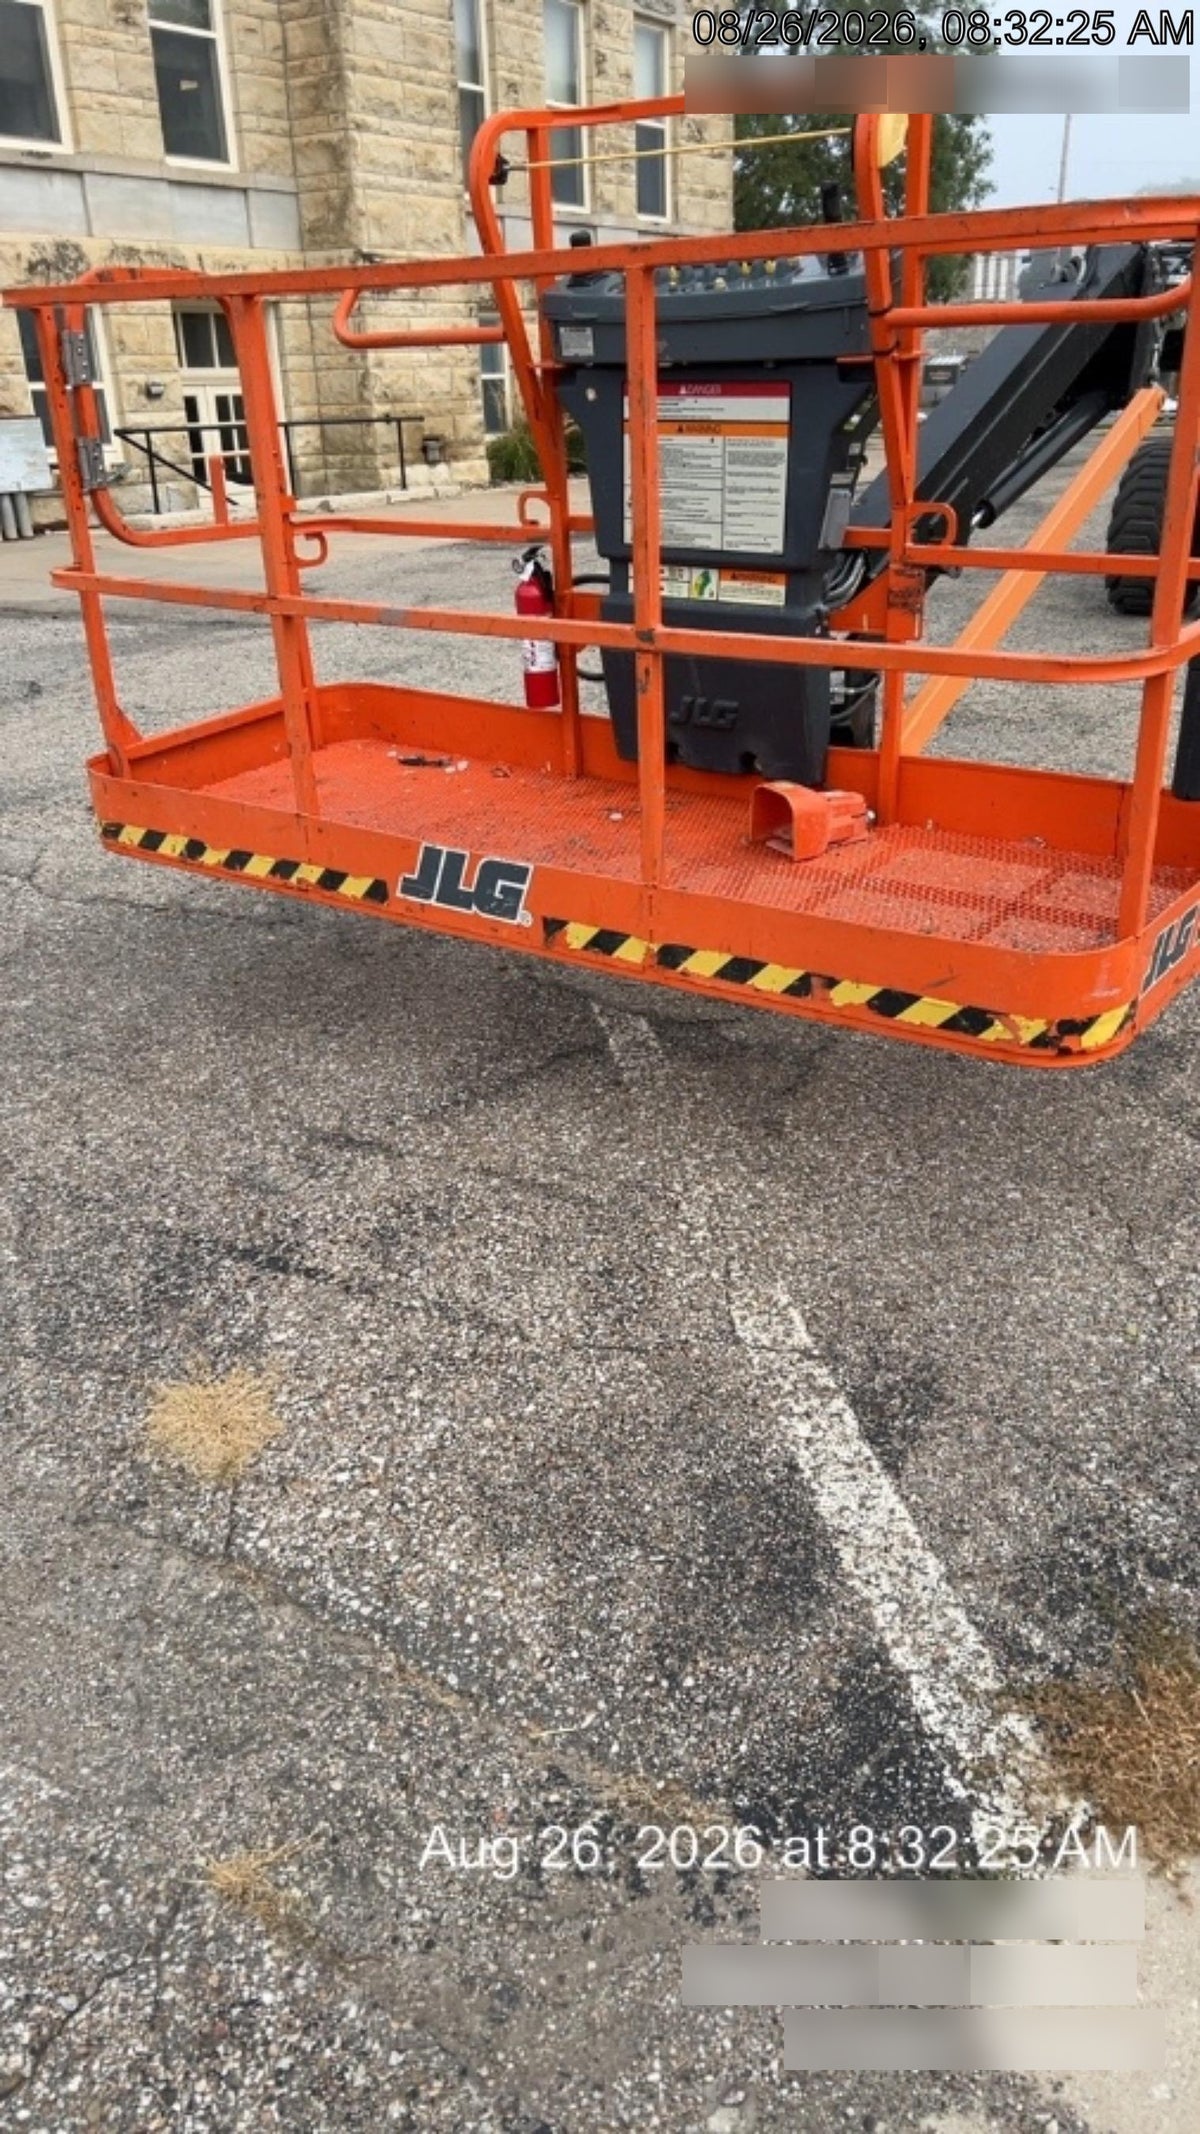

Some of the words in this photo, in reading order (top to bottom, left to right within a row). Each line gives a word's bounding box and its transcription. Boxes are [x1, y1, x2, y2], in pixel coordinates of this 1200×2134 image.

[669, 695, 740, 729] JLG
[397, 842, 534, 925] JLG
[1140, 902, 1199, 998] JLG
